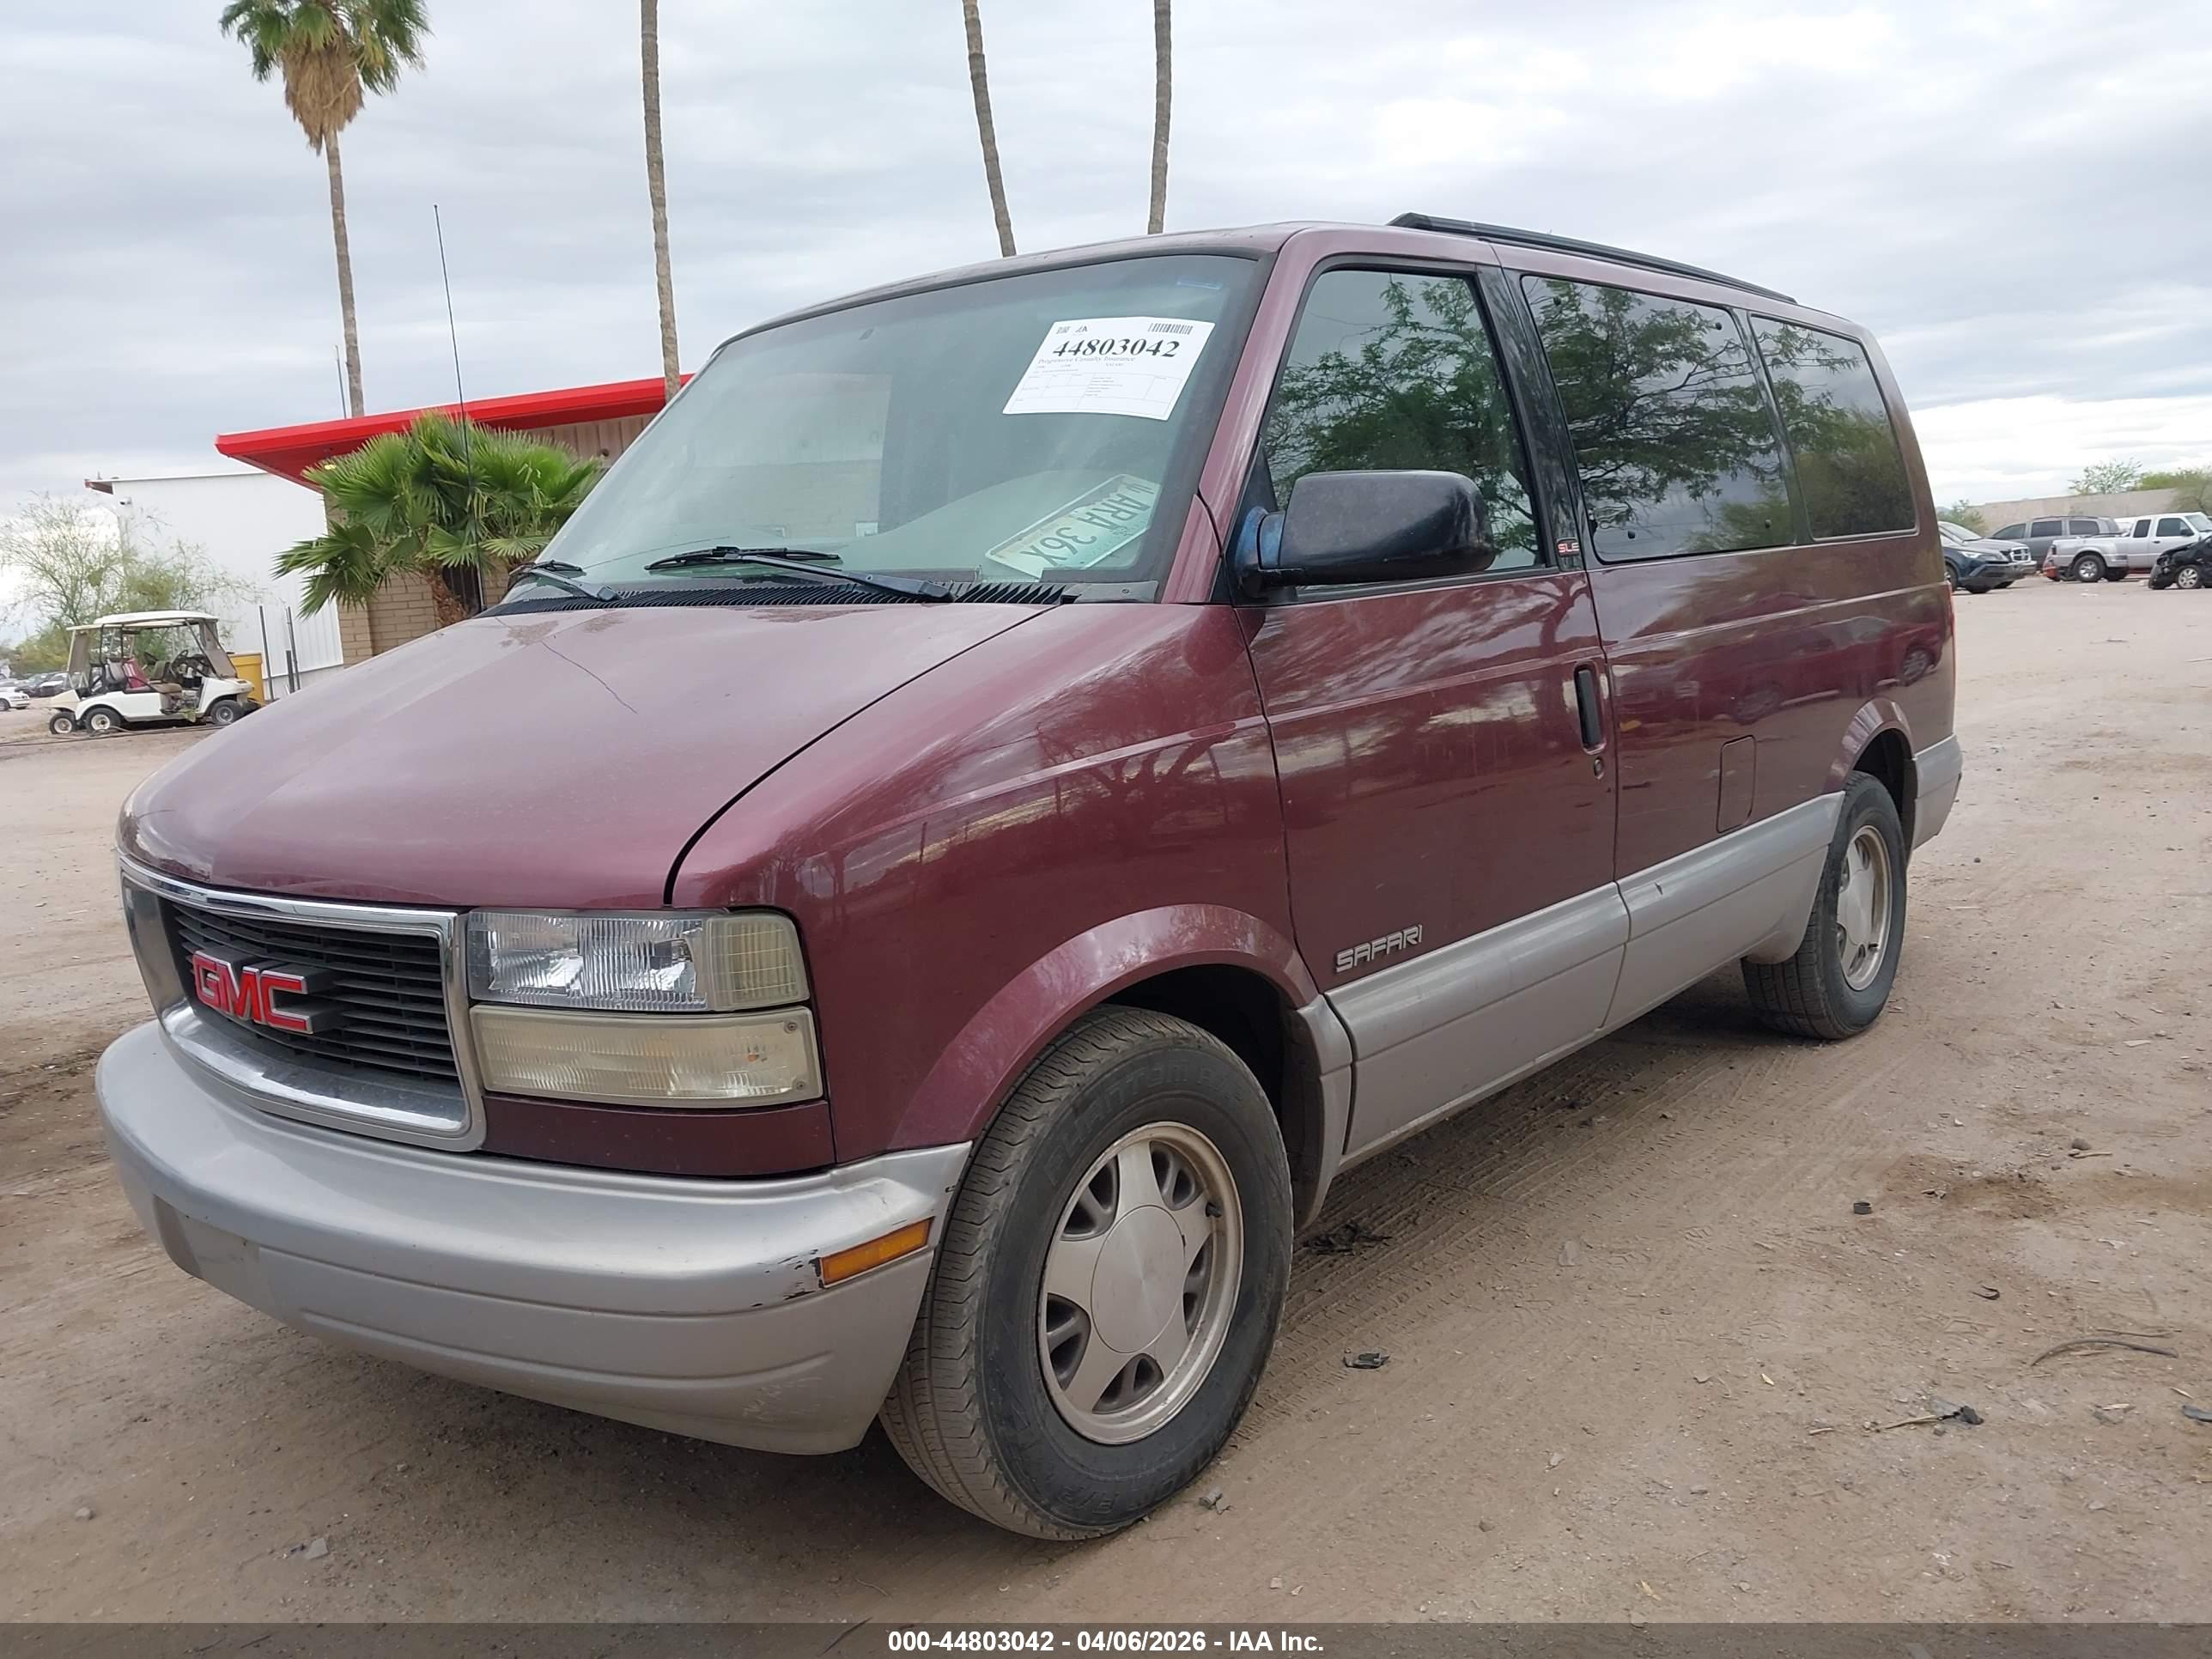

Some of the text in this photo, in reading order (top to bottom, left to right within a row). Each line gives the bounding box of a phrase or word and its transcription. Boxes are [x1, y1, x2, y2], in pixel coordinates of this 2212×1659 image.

[1053, 338, 1180, 357] 44803042
[1019, 493, 1152, 567] ARA 36X
[1558, 542, 1580, 553] SLE
[1335, 924, 1423, 974] SAFARI
[191, 950, 314, 1035] GMC
